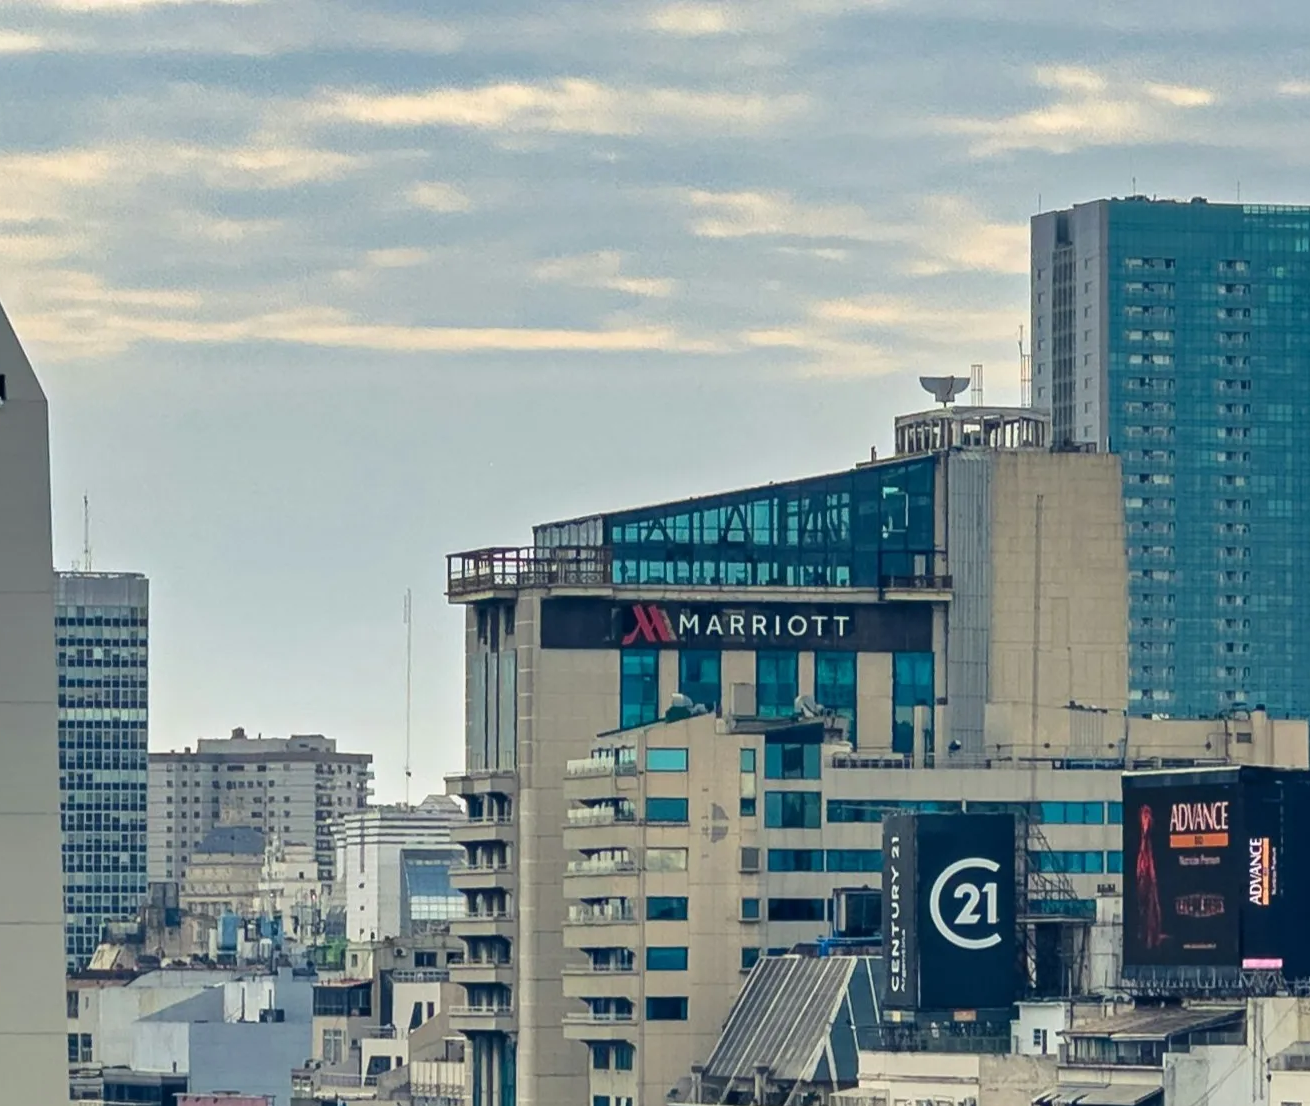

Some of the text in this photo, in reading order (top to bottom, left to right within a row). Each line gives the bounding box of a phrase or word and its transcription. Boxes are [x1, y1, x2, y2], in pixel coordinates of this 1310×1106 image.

[679, 614, 850, 637] MARRIOTT
[1169, 801, 1229, 832] ADVANCE
[1249, 837, 1263, 906] ADVANCE
[891, 836, 900, 992] CENTURY 21
